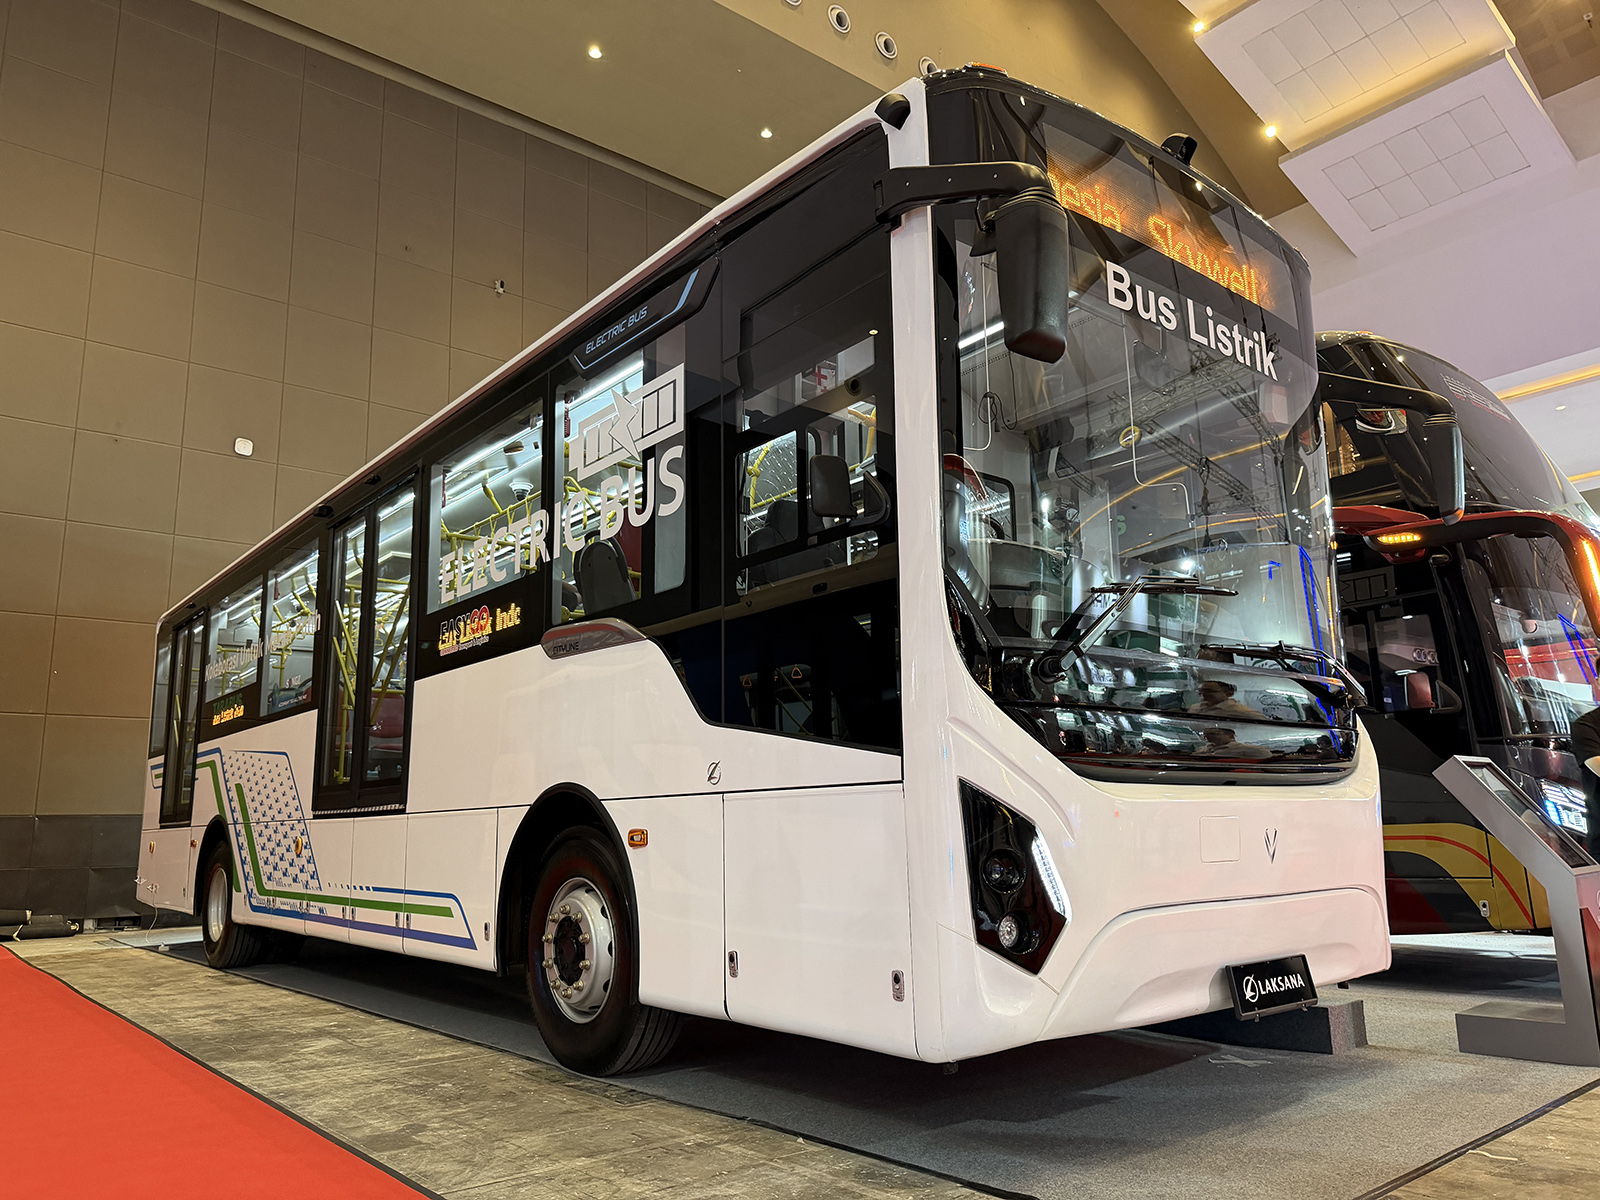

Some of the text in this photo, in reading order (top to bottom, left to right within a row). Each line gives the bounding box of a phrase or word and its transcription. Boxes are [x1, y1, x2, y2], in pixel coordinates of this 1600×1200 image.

[585, 306, 648, 354] ELECTRIC BUS
[1106, 260, 1278, 381] Bus Listrik
[441, 445, 685, 604] ELECTRIC BUS
[1258, 973, 1305, 995] LAKSANA
